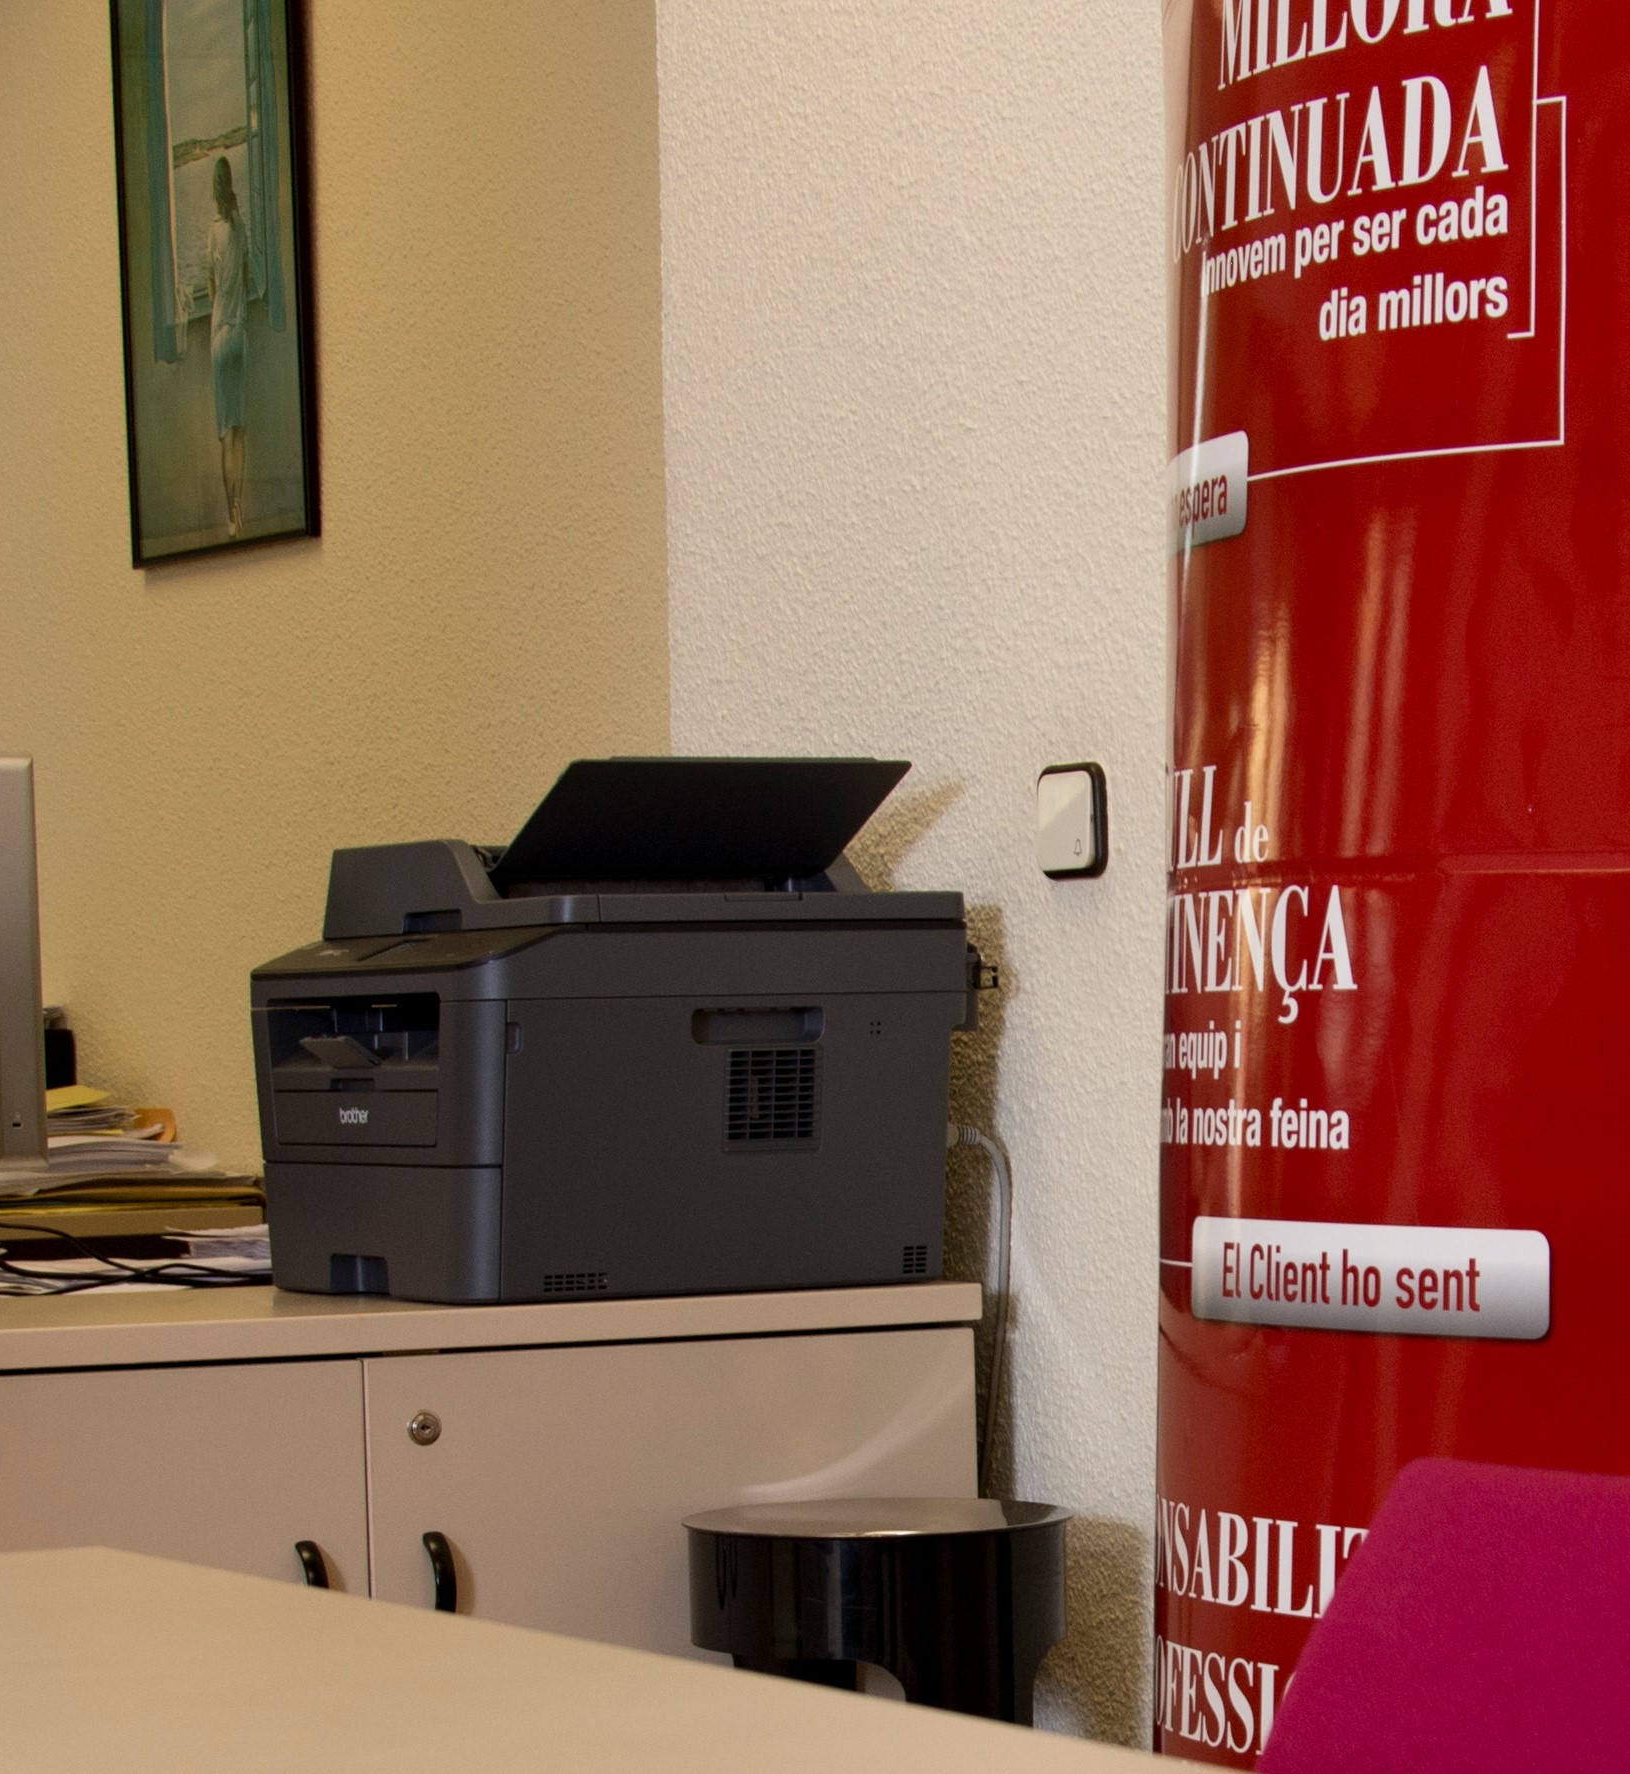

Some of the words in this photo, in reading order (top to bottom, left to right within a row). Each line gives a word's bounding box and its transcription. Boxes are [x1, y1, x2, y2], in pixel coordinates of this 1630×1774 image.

[1218, 0, 1513, 90] MILL
[1174, 65, 1509, 264] CONTINUADA
[1294, 216, 1346, 277] per
[1353, 207, 1407, 256] ser
[1416, 185, 1508, 244] cada
[1319, 286, 1367, 341] dia
[1378, 272, 1508, 331] millors
[1234, 801, 1269, 864] de
[1166, 884, 1358, 1024] INENÇA
[1179, 1020, 1228, 1080] equip
[1234, 1020, 1242, 1069] i
[338, 1106, 370, 1124] brother
[1176, 1097, 1189, 1145] la
[1192, 1099, 1262, 1148] nostra
[1270, 1098, 1350, 1149] feina
[1221, 1241, 1241, 1298] El
[1249, 1241, 1331, 1305] Client
[1341, 1248, 1382, 1308] ho
[1394, 1258, 1480, 1313] sent
[1156, 1494, 1369, 1619] NSABILI
[1155, 1634, 1296, 1756] OFESSI
